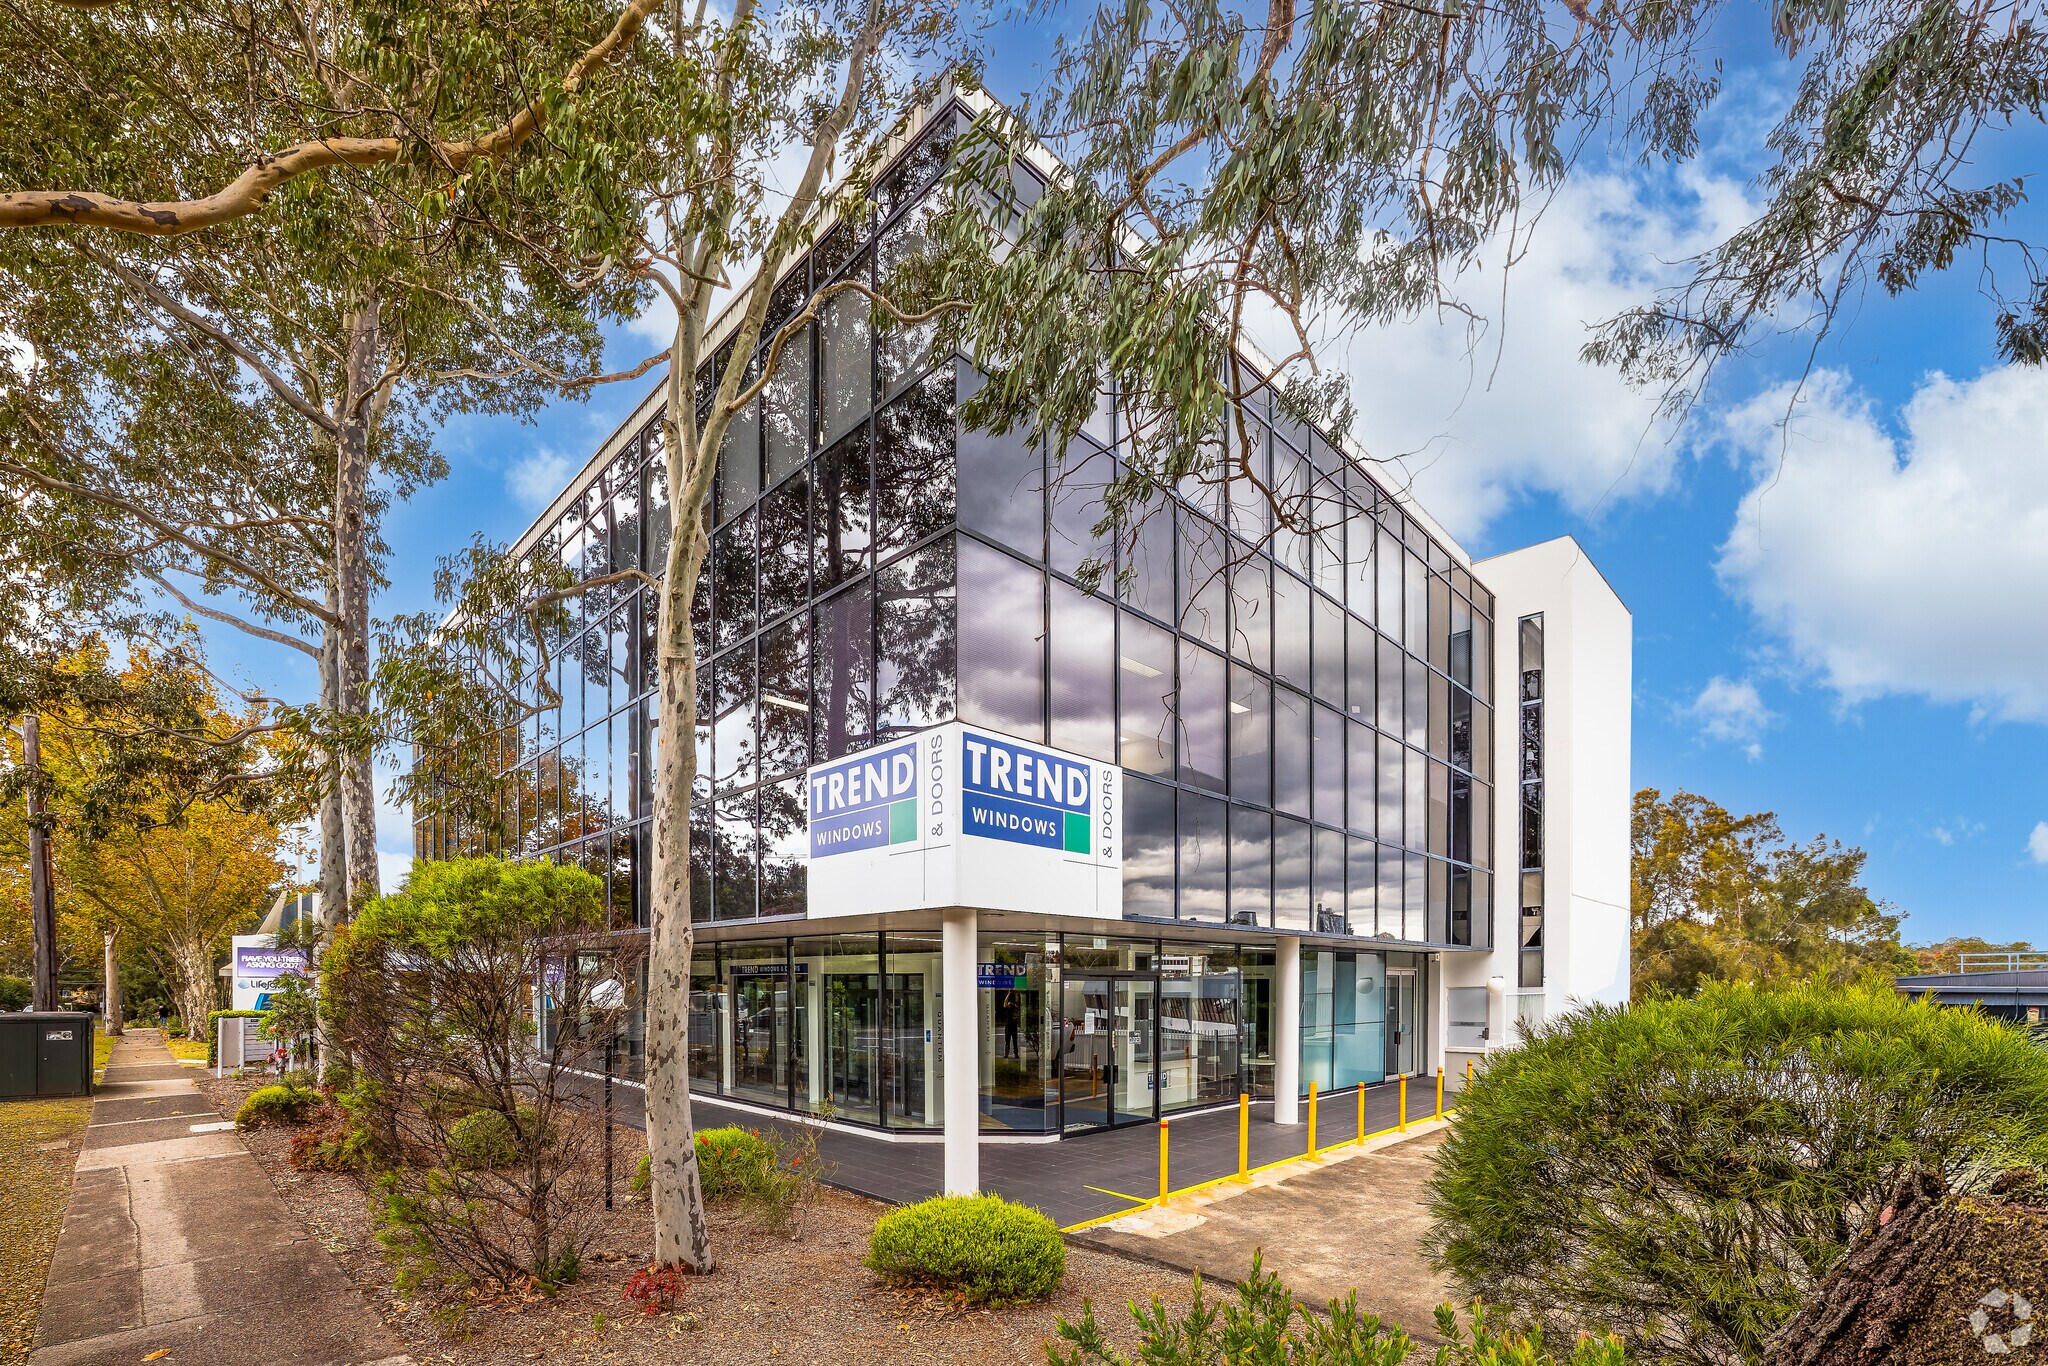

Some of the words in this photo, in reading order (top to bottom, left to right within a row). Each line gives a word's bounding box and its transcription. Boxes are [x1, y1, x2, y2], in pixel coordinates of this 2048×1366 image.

[812, 752, 914, 814] TREND
[931, 734, 943, 816] DOORS
[966, 740, 1088, 806] TREND
[1102, 770, 1113, 840] DOORS
[816, 820, 882, 846] WINDOWS
[931, 822, 943, 836] &
[972, 806, 1056, 837] WINDOWS
[1102, 846, 1112, 858] &
[742, 965, 759, 974] TREND
[977, 964, 1026, 976] TREND
